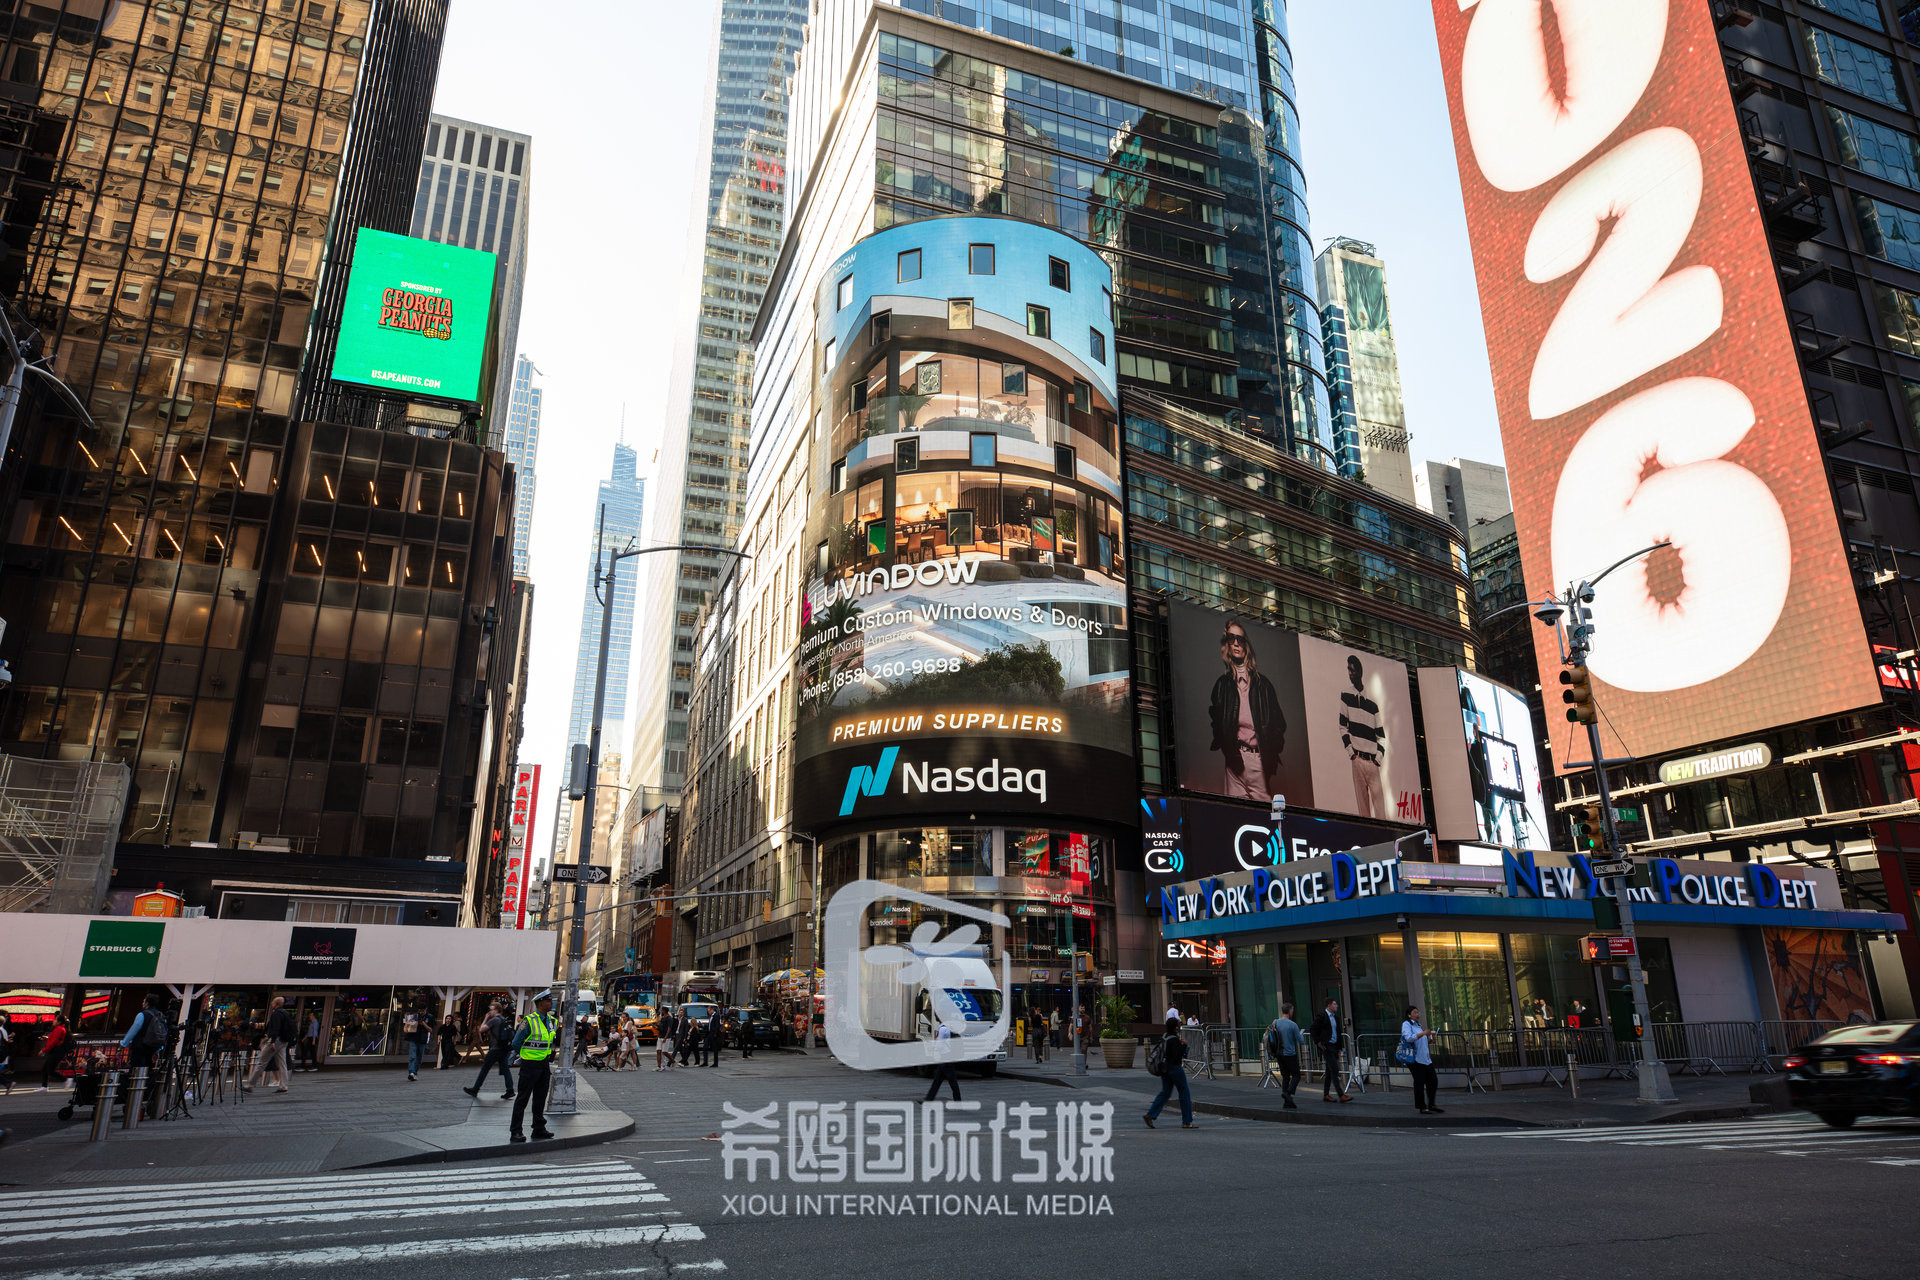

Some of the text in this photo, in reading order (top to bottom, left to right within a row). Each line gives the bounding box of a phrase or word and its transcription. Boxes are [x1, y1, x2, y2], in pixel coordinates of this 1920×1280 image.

[382, 287, 453, 318] GEORGIA
[400, 281, 442, 295] SPONSORED BY
[378, 306, 452, 334] PEANUTS
[371, 369, 441, 389] USAPEANUTS.COM
[812, 559, 980, 616] LUVINDOW
[843, 609, 913, 634] Custom
[921, 602, 1022, 621] Windows
[1030, 605, 1044, 624] &
[1051, 608, 1103, 636] Doors
[838, 638, 864, 654] North
[803, 657, 961, 702] Phone: (858) 260-9698
[833, 713, 1063, 742] PREMIUM SUPPLIERS
[903, 758, 1047, 804] Nasdaq
[513, 772, 531, 825] PARK
[1396, 790, 1422, 822] H&M
[1502, 848, 1576, 899] NEW
[1652, 858, 1750, 906] POLICE
[1752, 863, 1817, 909] DEPT
[1595, 863, 1629, 874] ONE WAY
[503, 857, 521, 912] PARK
[1161, 852, 1399, 924] NEW YORK POLICE DEPT
[89, 945, 142, 953] STARBUCKS
[1167, 943, 1202, 958] EXL
